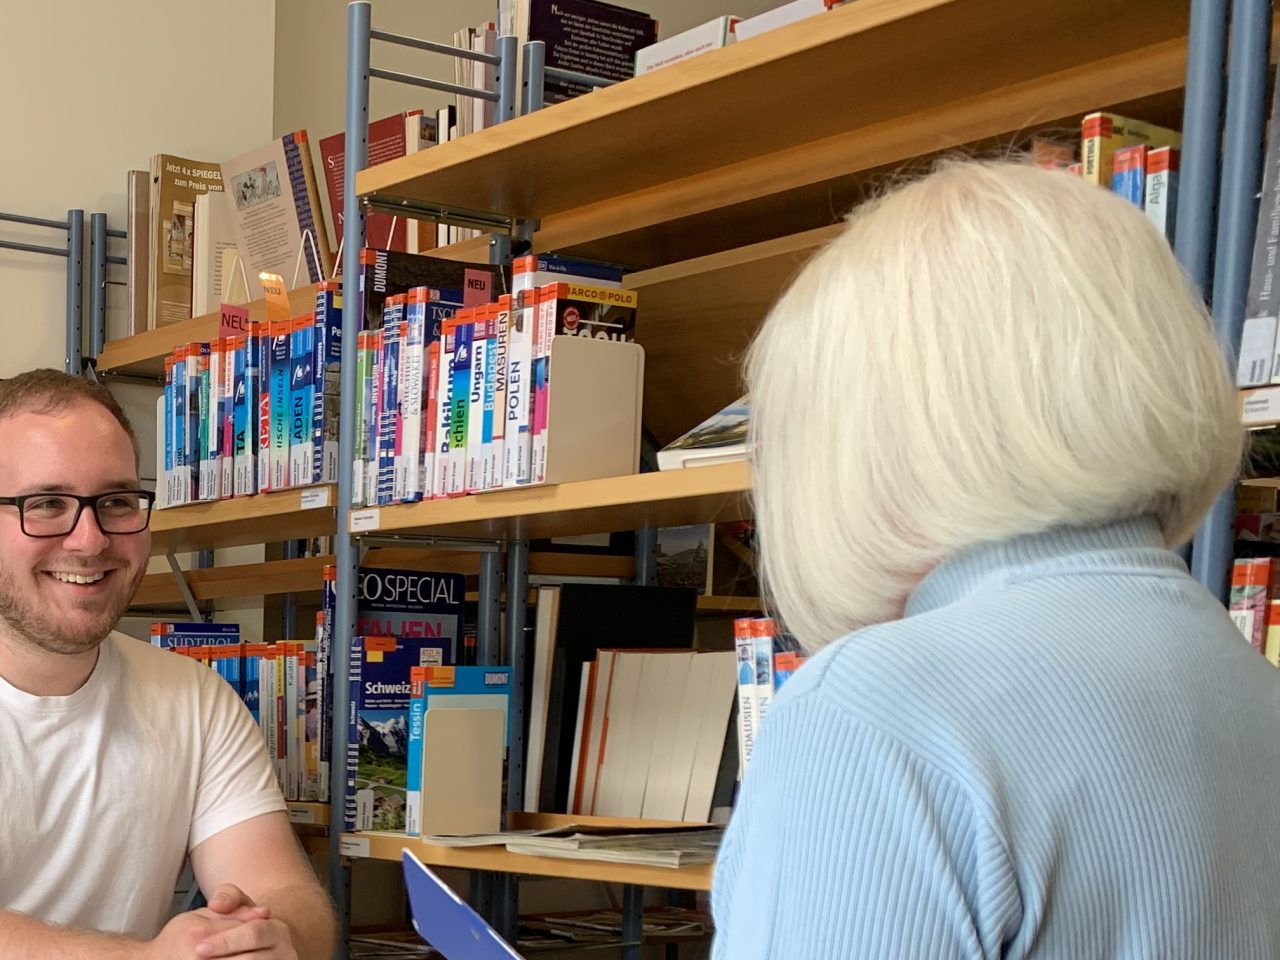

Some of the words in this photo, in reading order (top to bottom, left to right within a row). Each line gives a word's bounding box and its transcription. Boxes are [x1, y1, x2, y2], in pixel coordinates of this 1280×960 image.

[166, 163, 181, 174] Jetzt
[192, 169, 222, 180] SPIEGEL
[1087, 139, 1095, 176] PORTUGA
[174, 178, 188, 188] zum
[188, 180, 207, 190] Preis
[208, 182, 223, 191] von
[1150, 174, 1166, 205] Alga
[373, 251, 388, 292] DUMONT
[468, 278, 486, 292] NEU
[1260, 269, 1273, 301] Haus-
[263, 286, 281, 296] NEU
[608, 292, 632, 304] POLO
[432, 324, 441, 337] &
[495, 312, 509, 392] MASUREN
[411, 354, 420, 406] SLOWAKEI
[471, 345, 483, 403] Ungarn
[483, 342, 497, 411] Budapest
[508, 361, 521, 421] POLEN
[293, 396, 304, 443] ADEN
[358, 574, 382, 601] EO
[384, 576, 460, 605] SPECIAL
[365, 682, 411, 697] Schweiz
[485, 672, 510, 686] DUMONT
[410, 702, 422, 742] Tessin
[743, 696, 754, 762] NDALUSIEN
